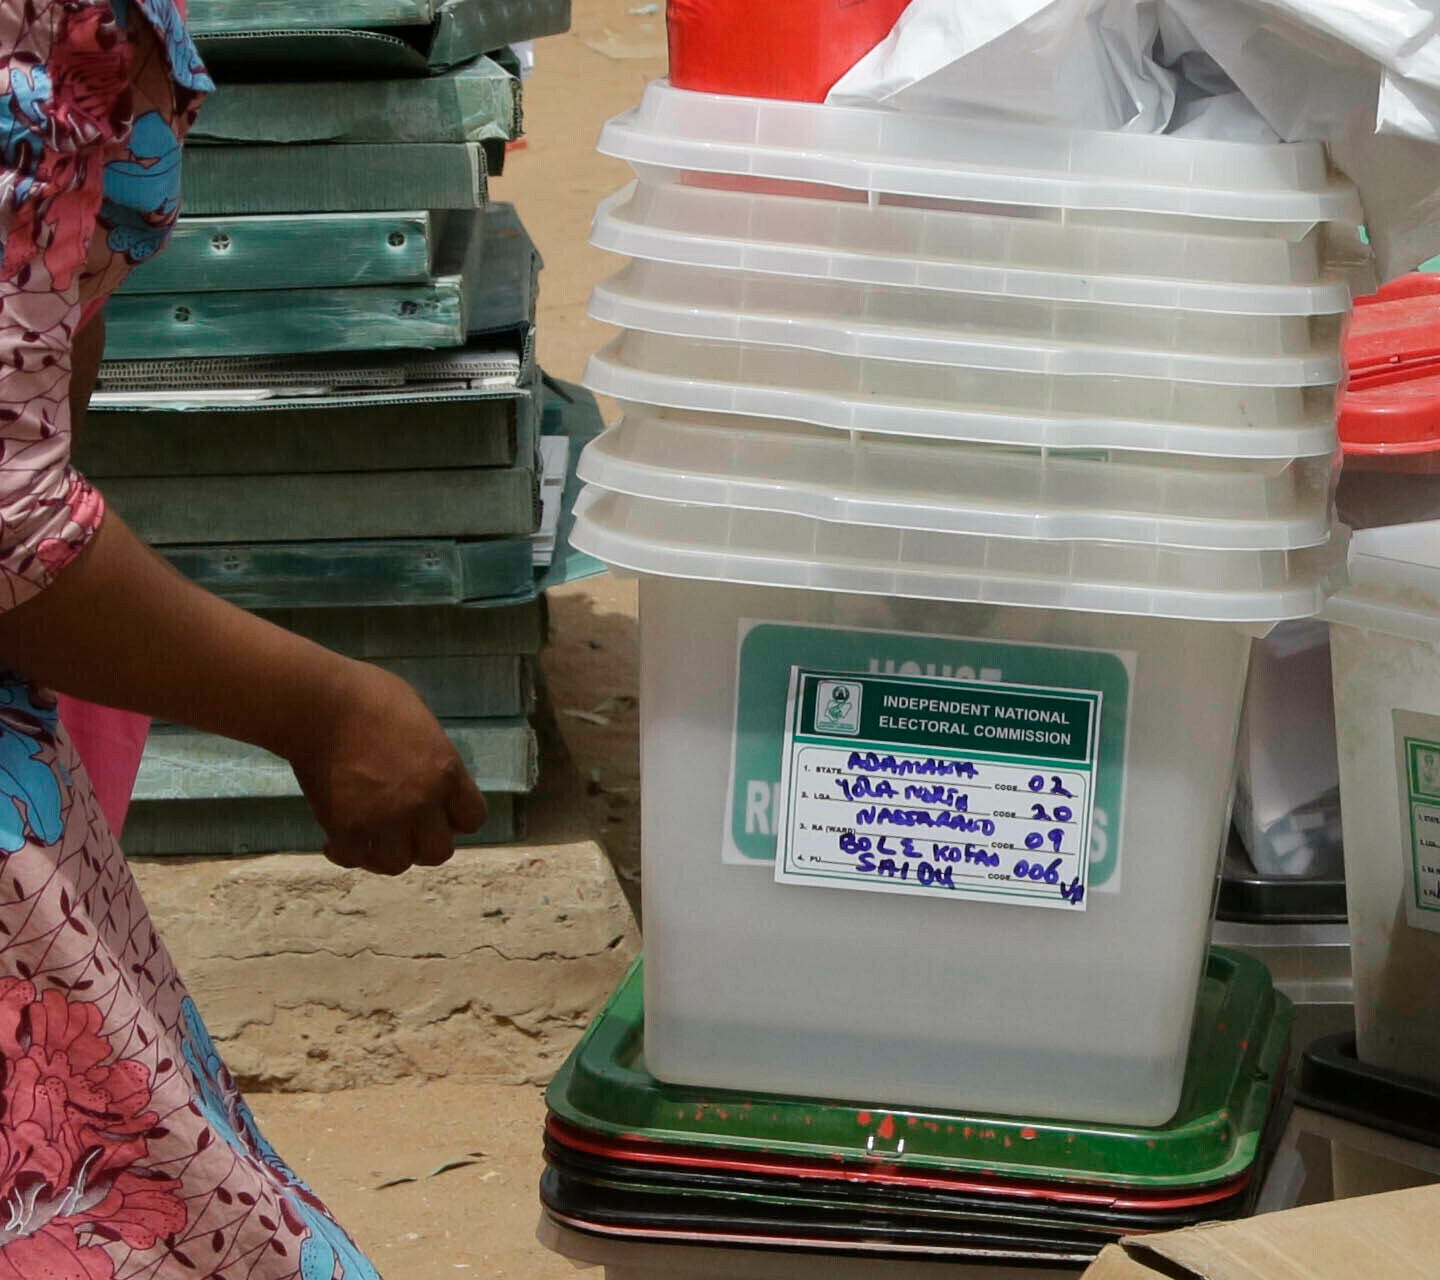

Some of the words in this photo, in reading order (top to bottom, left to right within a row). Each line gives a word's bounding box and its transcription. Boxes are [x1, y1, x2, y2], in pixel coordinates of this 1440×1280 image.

[883, 695, 991, 718] INDEPENDENT
[994, 706, 1070, 725] NATIONAL
[879, 715, 970, 736] ELECTORAL
[974, 726, 1071, 746] COMMISSION
[815, 766, 842, 775] STATE
[1028, 775, 1072, 798] 02
[1031, 804, 1073, 821] 20
[1013, 858, 1062, 884] 006
